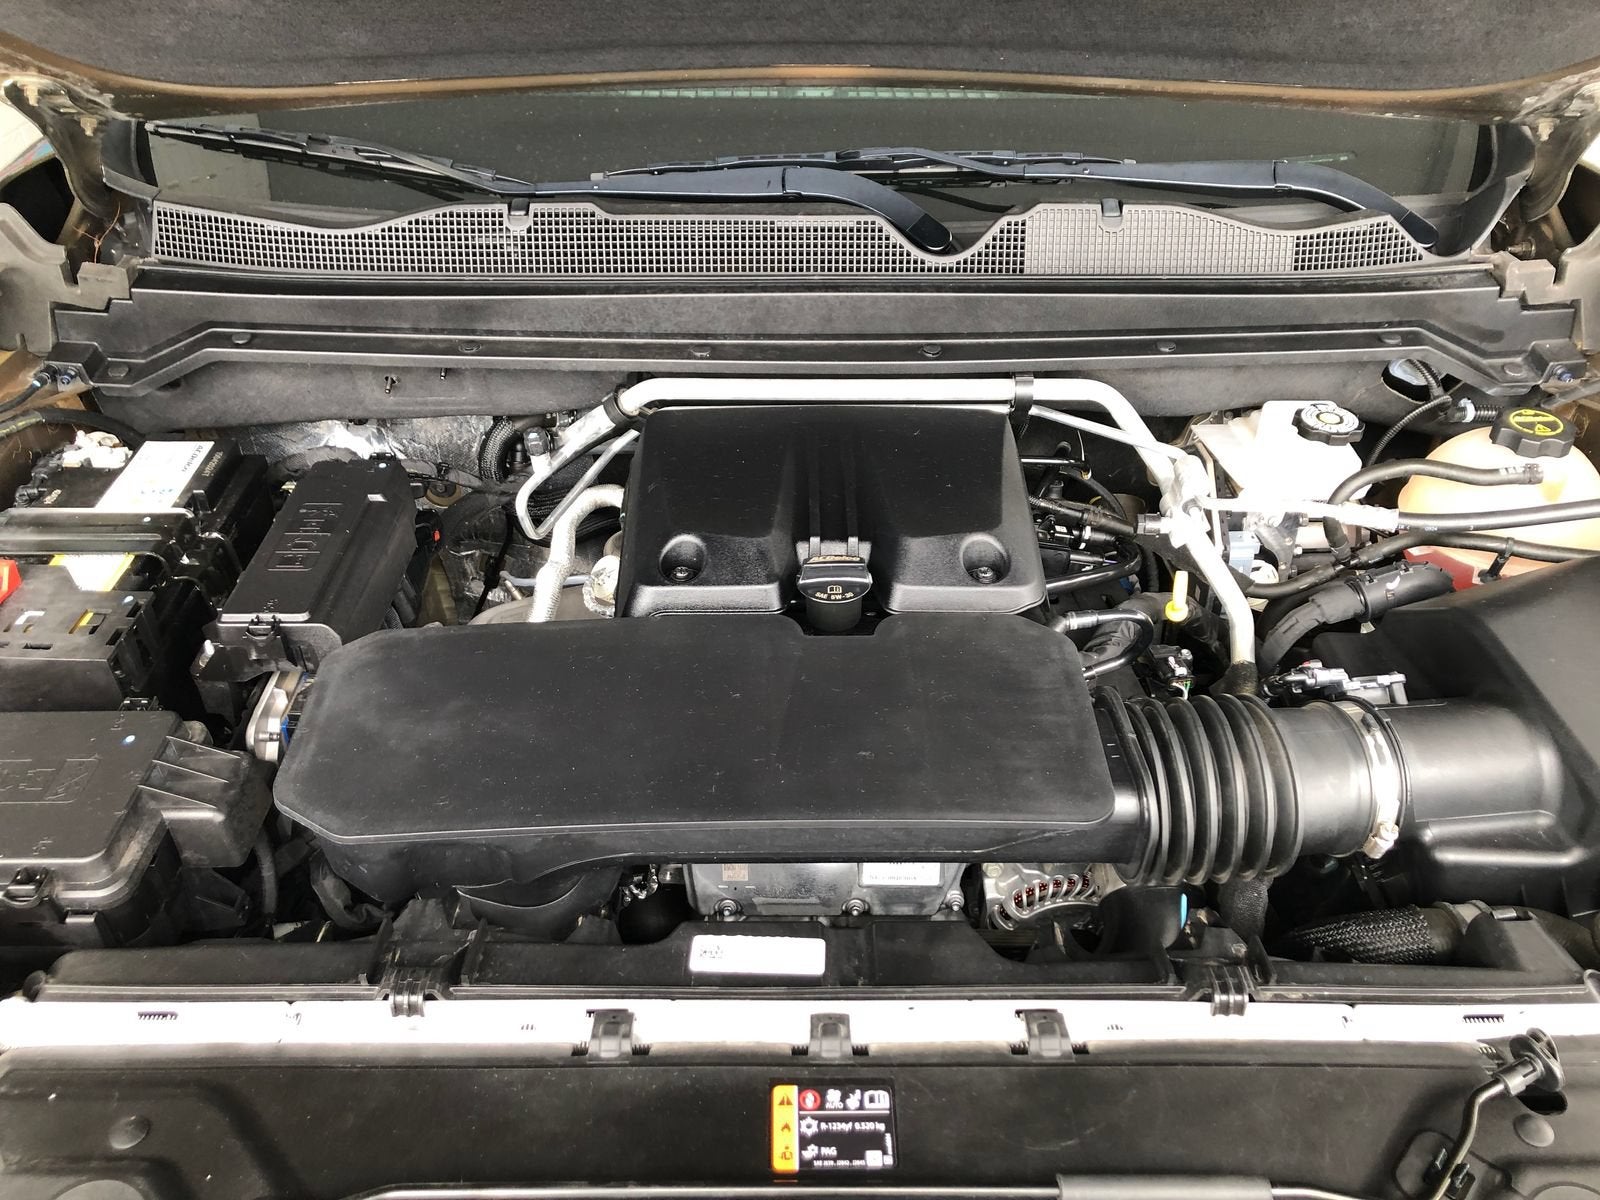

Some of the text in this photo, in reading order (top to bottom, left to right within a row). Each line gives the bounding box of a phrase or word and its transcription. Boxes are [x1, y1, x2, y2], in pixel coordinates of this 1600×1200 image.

[815, 591, 828, 600] SAE
[825, 1101, 844, 1109] AUTO
[875, 1121, 885, 1131] kg
[820, 1147, 837, 1155] PAG
